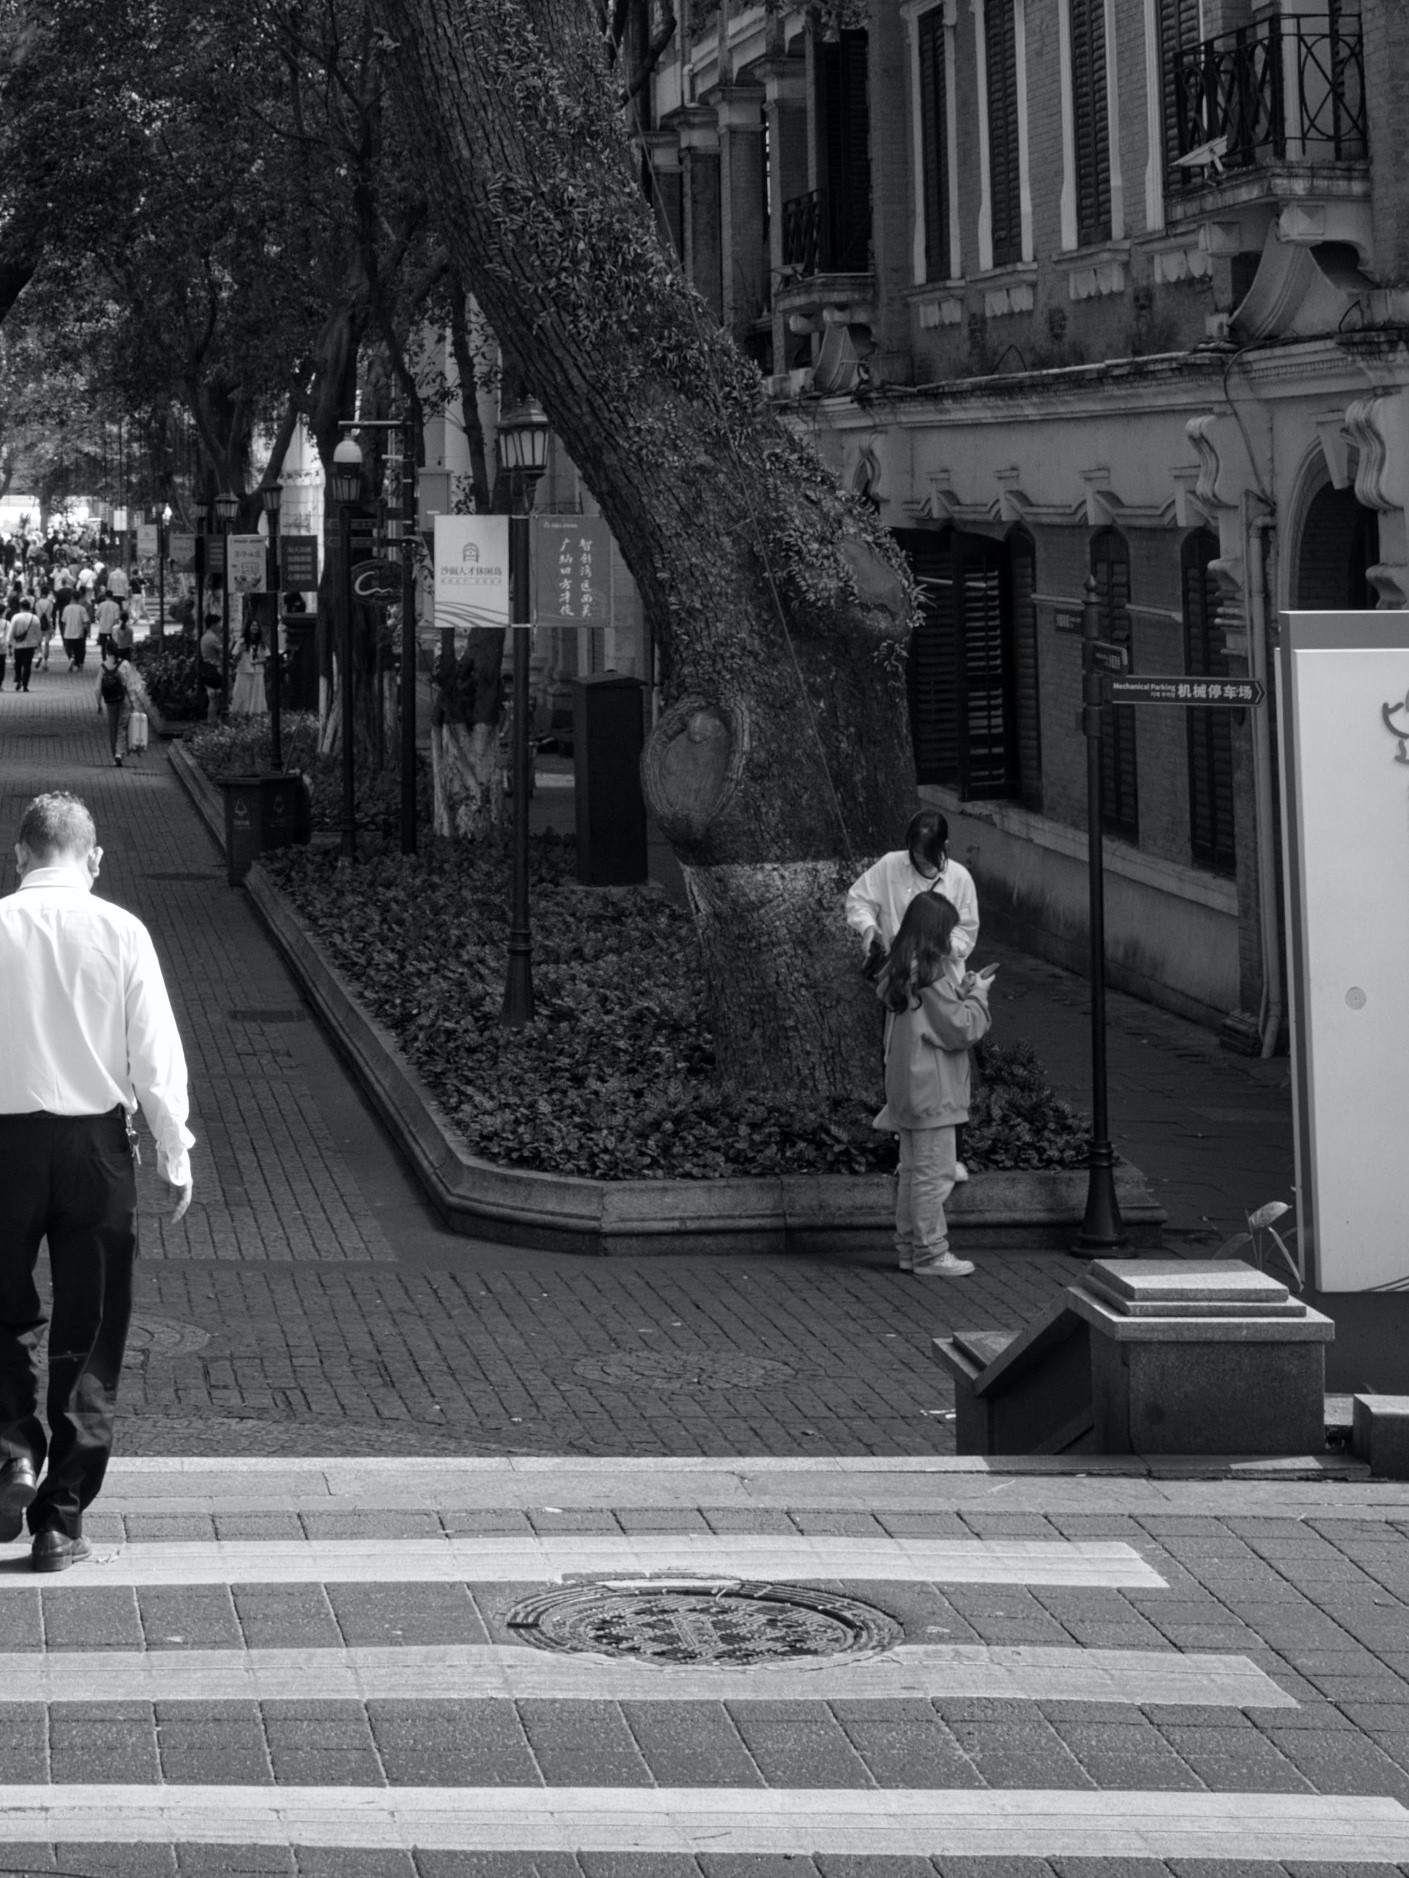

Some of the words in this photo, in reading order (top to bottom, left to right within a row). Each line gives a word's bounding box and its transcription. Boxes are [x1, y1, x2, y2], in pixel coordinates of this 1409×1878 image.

[440, 566, 503, 577] 沙面人才休闲岛
[1112, 682, 1150, 690] Mechanical
[1150, 683, 1176, 692] Parking
[1177, 683, 1252, 699] 机械停车场
